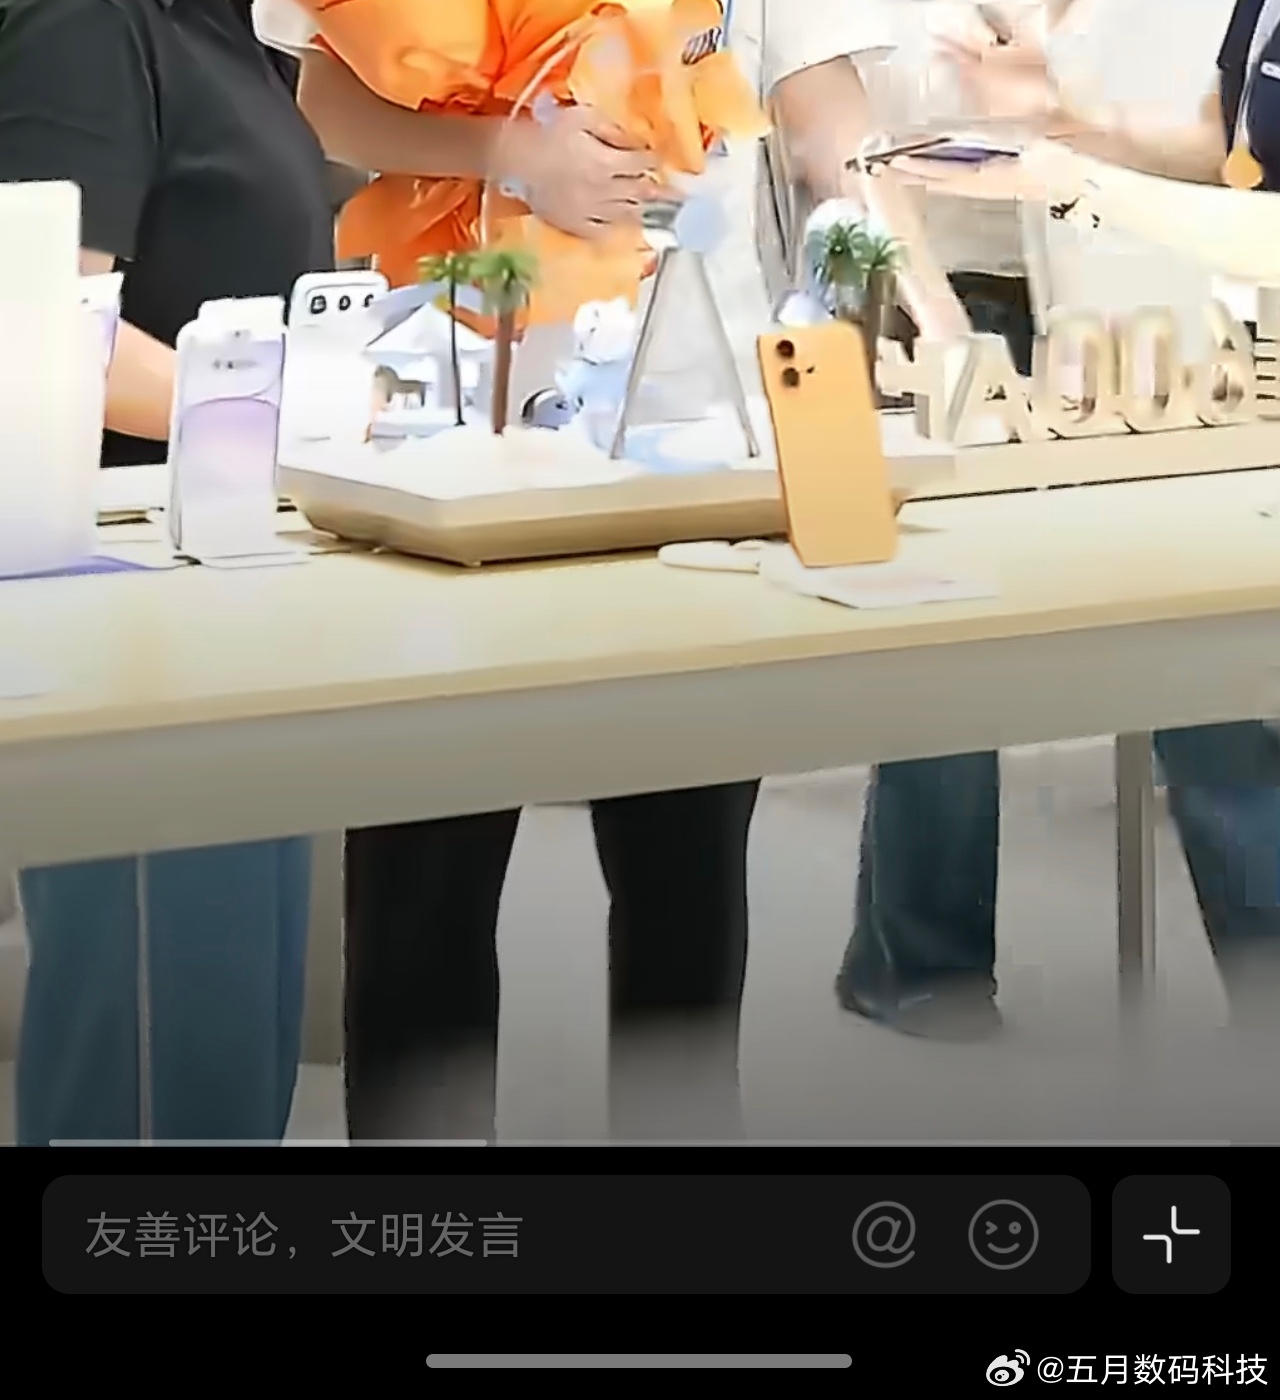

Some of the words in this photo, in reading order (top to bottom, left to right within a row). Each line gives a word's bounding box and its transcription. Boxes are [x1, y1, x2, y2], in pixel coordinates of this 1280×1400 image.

[85, 1211, 524, 1260] 友善评论，文明发言
